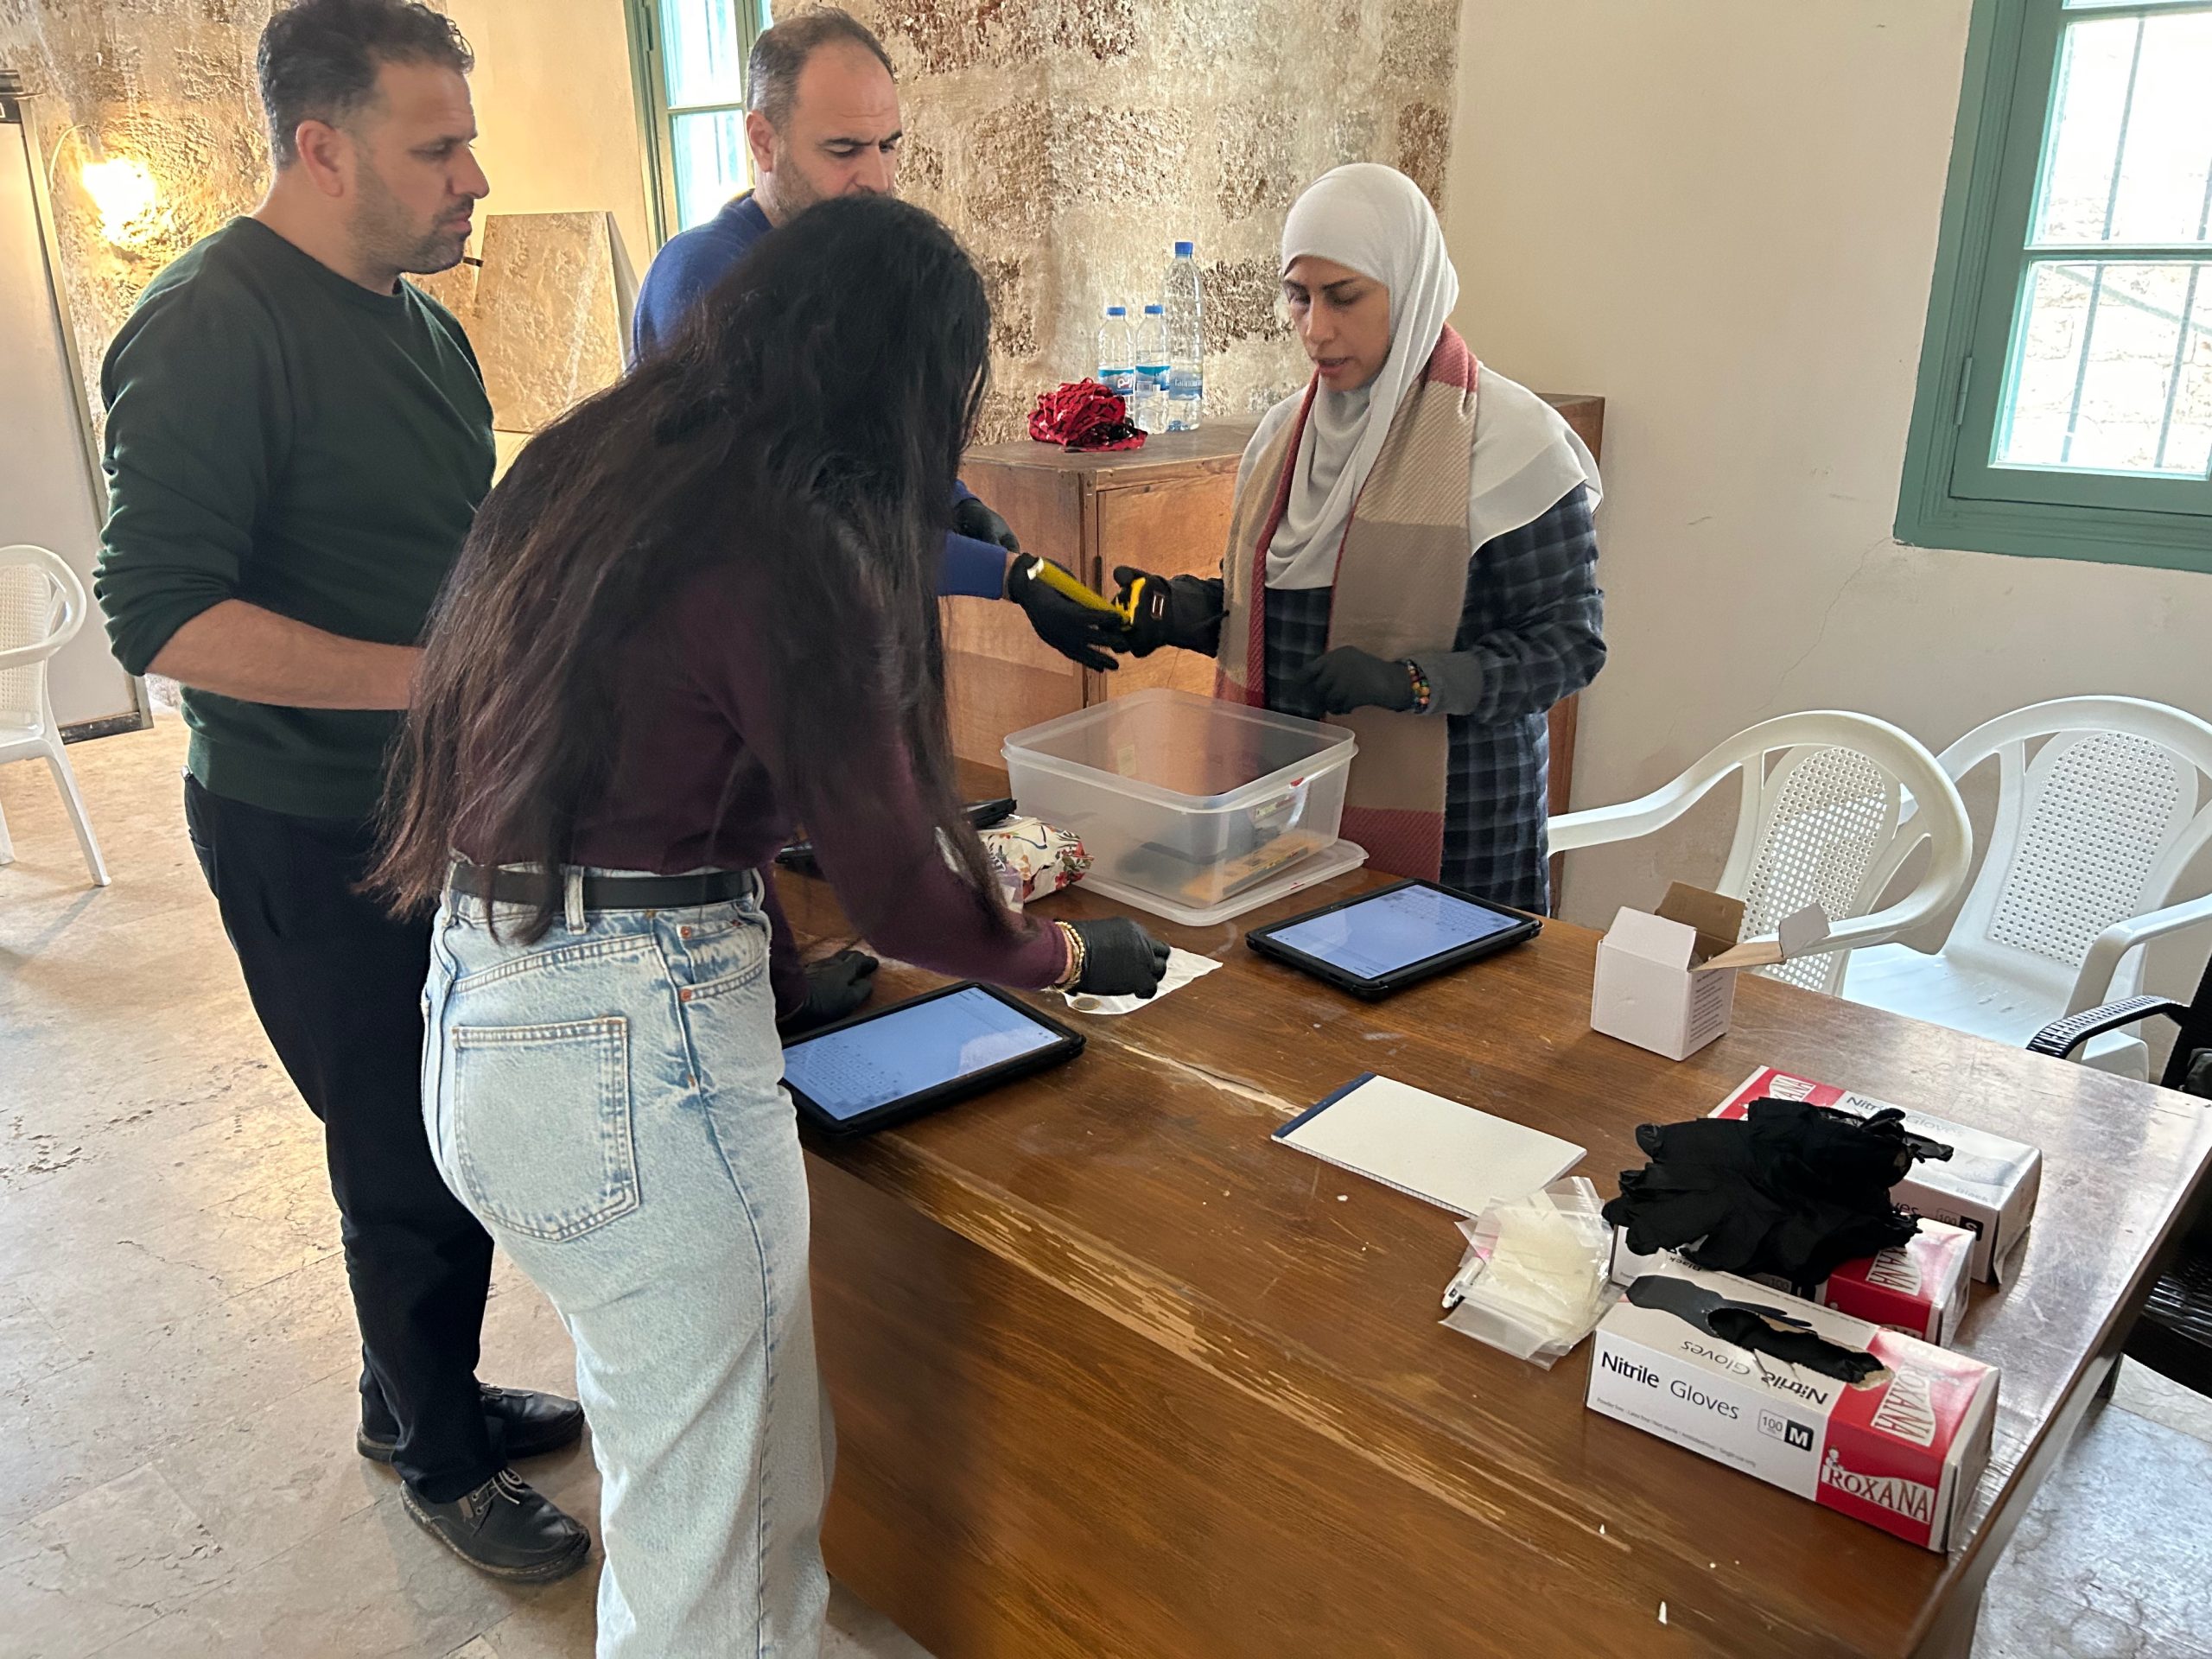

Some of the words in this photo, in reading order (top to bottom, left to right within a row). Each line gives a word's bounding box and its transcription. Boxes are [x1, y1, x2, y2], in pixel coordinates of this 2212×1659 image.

[1847, 1096, 1886, 1112] Nitri
[1681, 1340, 1751, 1376] Gloves
[1601, 1351, 1659, 1389] Nitrile
[1670, 1380, 1739, 1420] Gloves
[1761, 1371, 1828, 1406] Nitrile
[1873, 1363, 1934, 1440] ROXANA
[1763, 1416, 1783, 1432] 100
[1789, 1427, 1808, 1447] M
[1827, 1466, 1929, 1522] ROXANA
